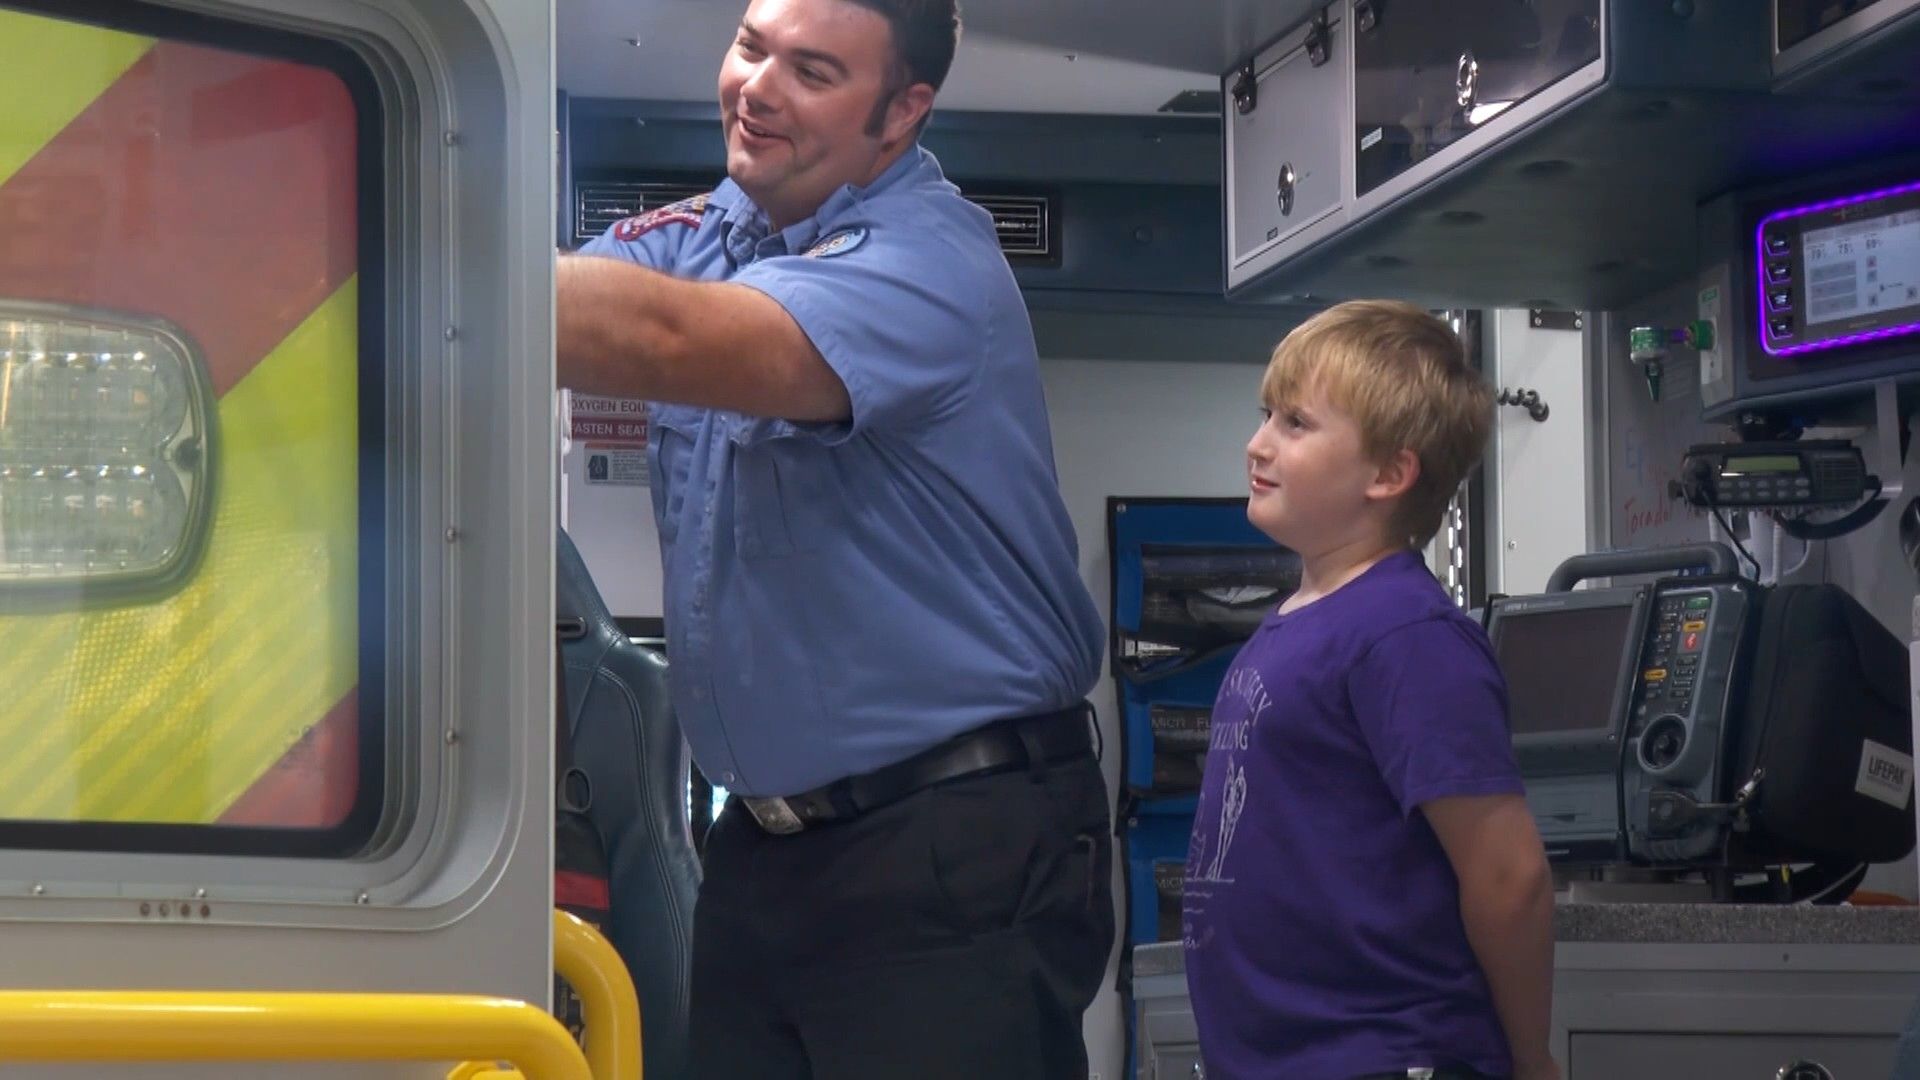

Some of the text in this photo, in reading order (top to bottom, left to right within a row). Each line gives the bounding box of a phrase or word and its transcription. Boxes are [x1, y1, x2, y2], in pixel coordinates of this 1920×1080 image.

[571, 399, 617, 412] OXYGEN
[571, 422, 646, 435] ASTEN SEAT
